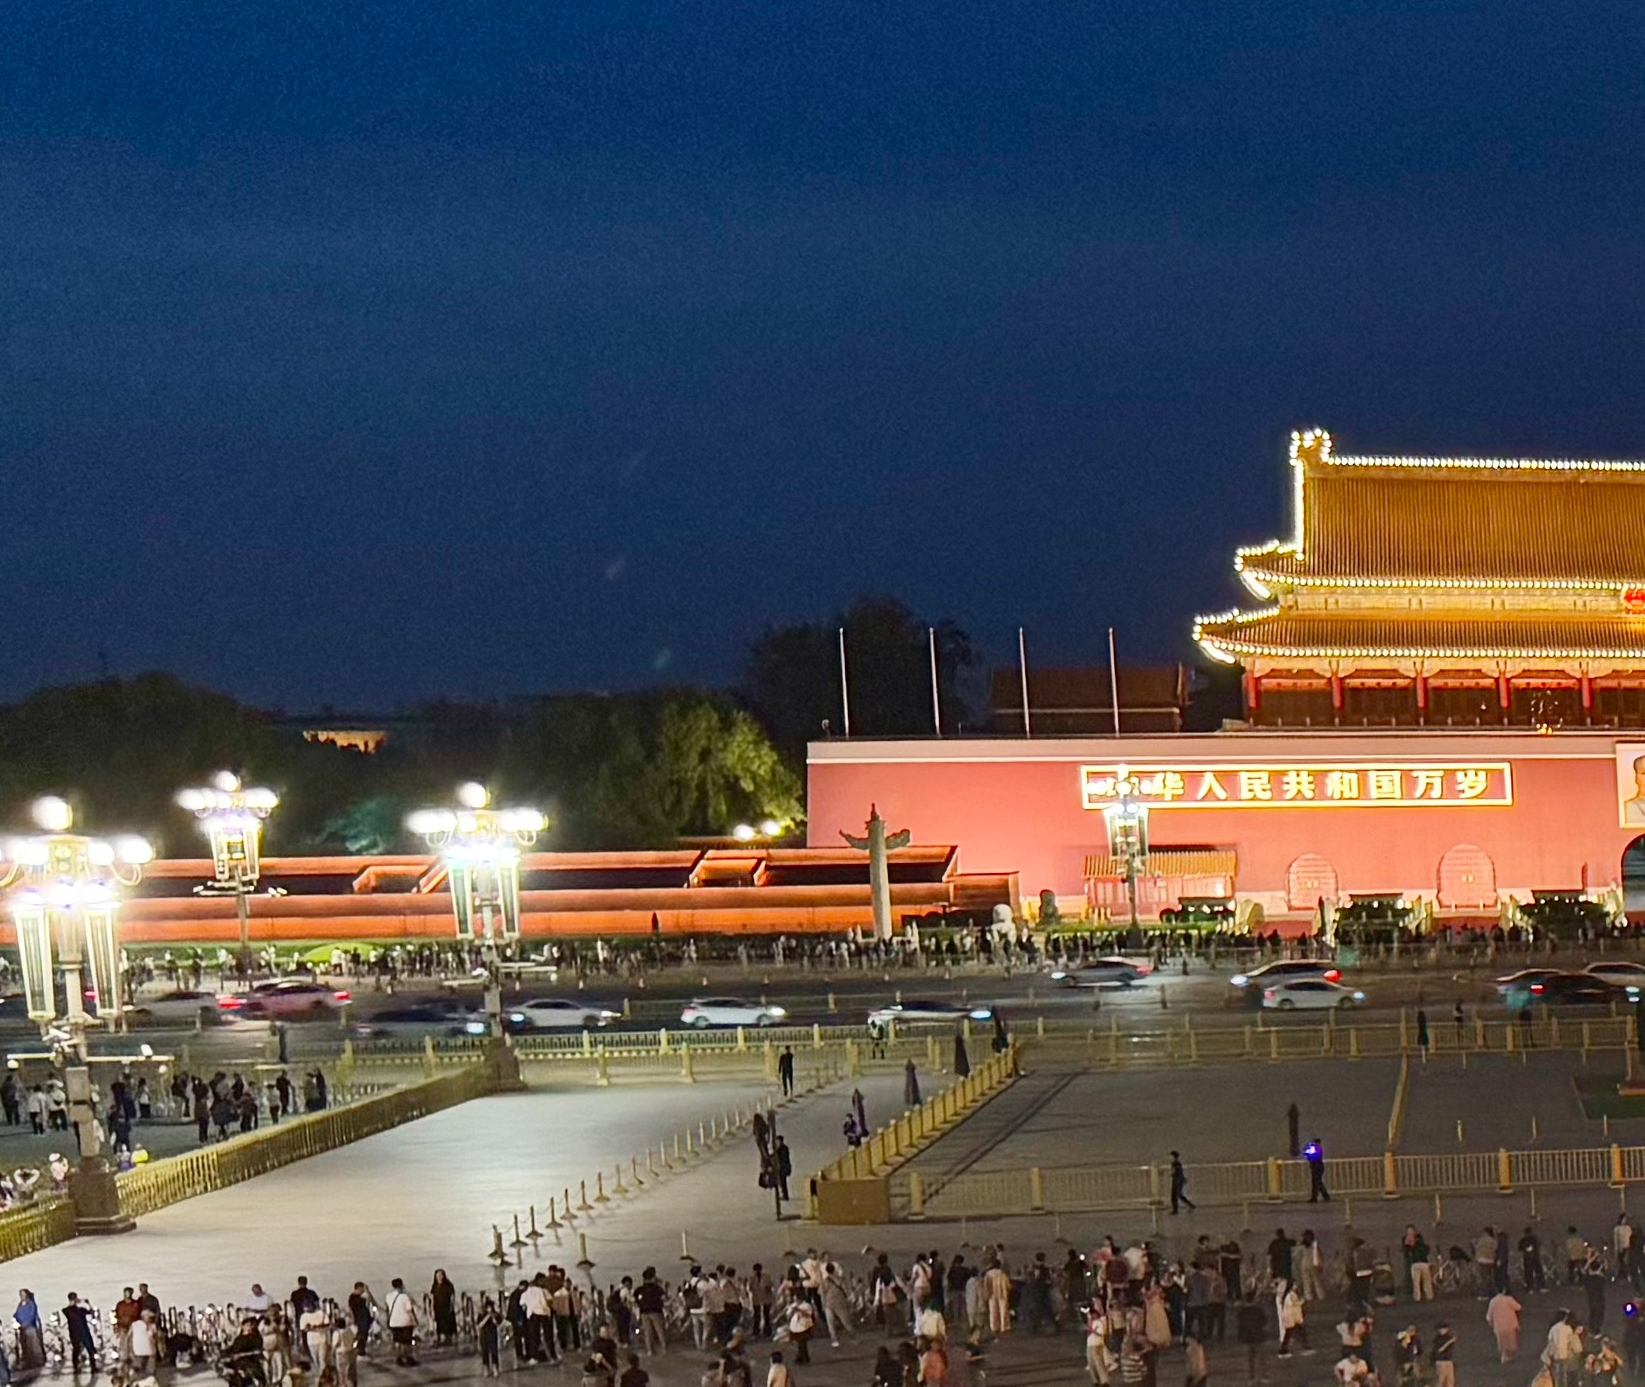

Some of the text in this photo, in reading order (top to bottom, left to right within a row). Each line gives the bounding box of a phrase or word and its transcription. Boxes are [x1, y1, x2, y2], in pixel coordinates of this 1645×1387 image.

[1107, 770, 1488, 801] 华人民共和国万岁
